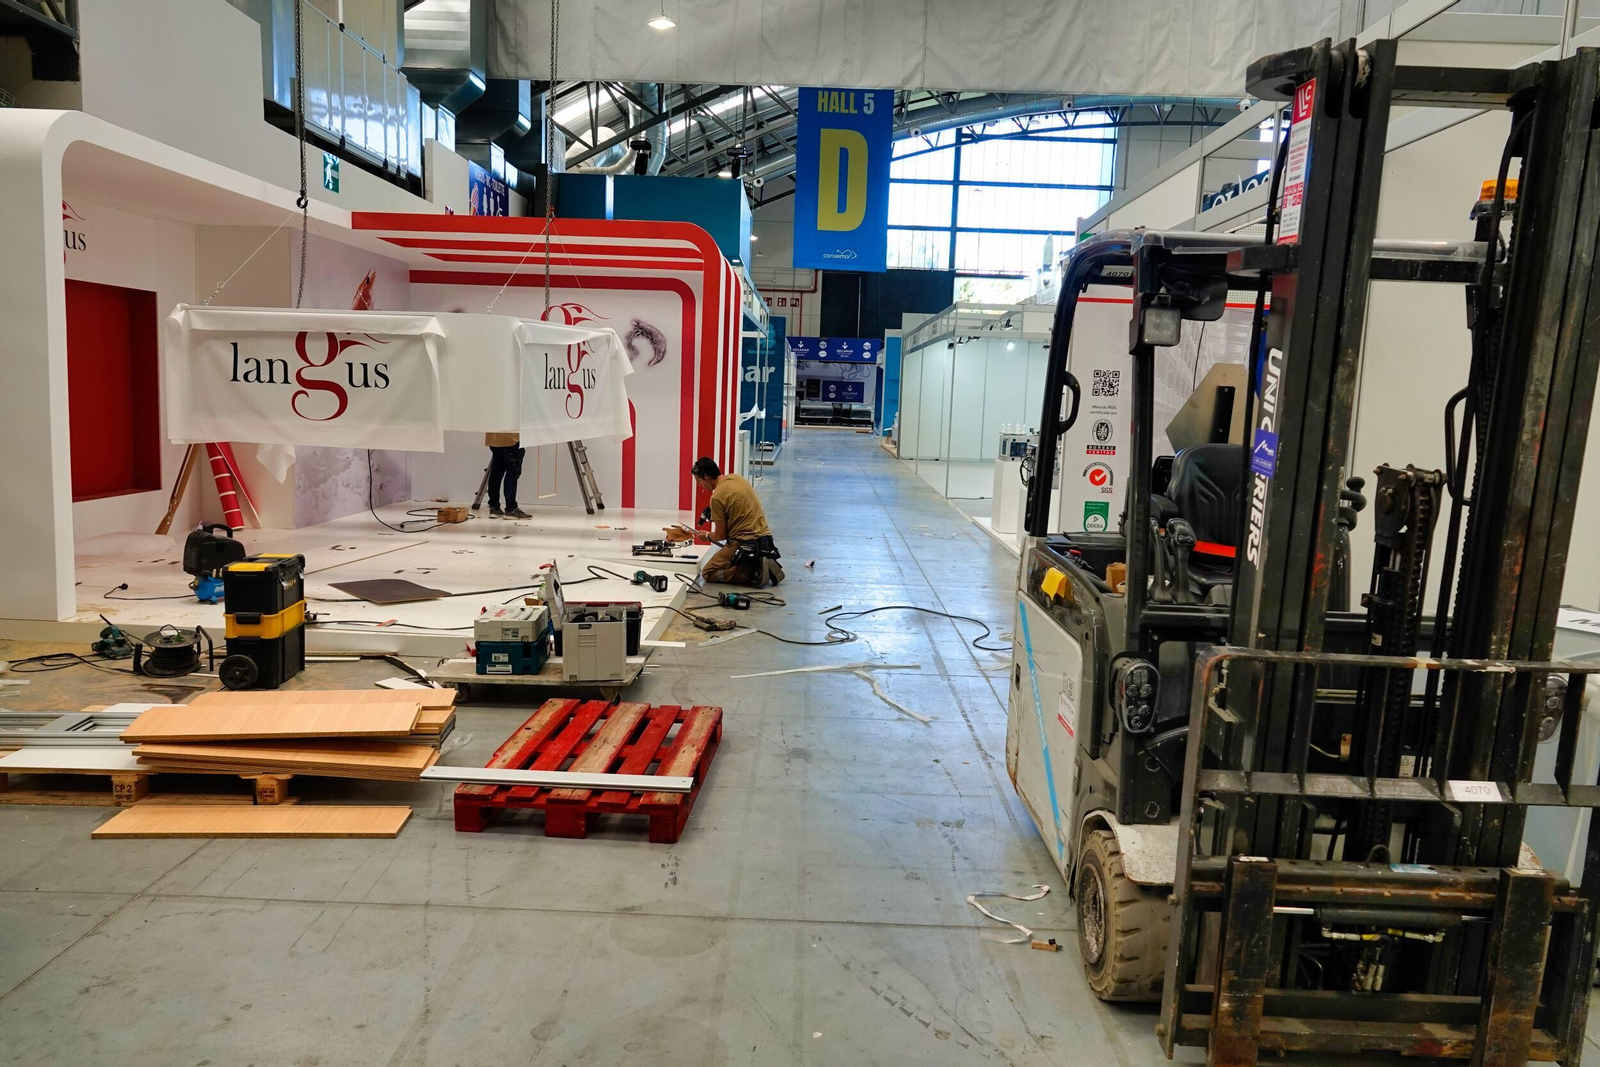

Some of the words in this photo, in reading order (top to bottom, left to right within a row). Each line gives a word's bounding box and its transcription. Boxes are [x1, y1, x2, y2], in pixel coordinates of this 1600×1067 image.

[817, 90, 859, 114] HALL
[863, 92, 875, 115] 5
[816, 127, 869, 232] D
[229, 331, 391, 422] langus
[543, 341, 597, 420] langus
[1100, 486, 1113, 494] SGS
[114, 784, 125, 793] CP
[126, 785, 132, 793] 2
[1464, 785, 1491, 795] 4070
